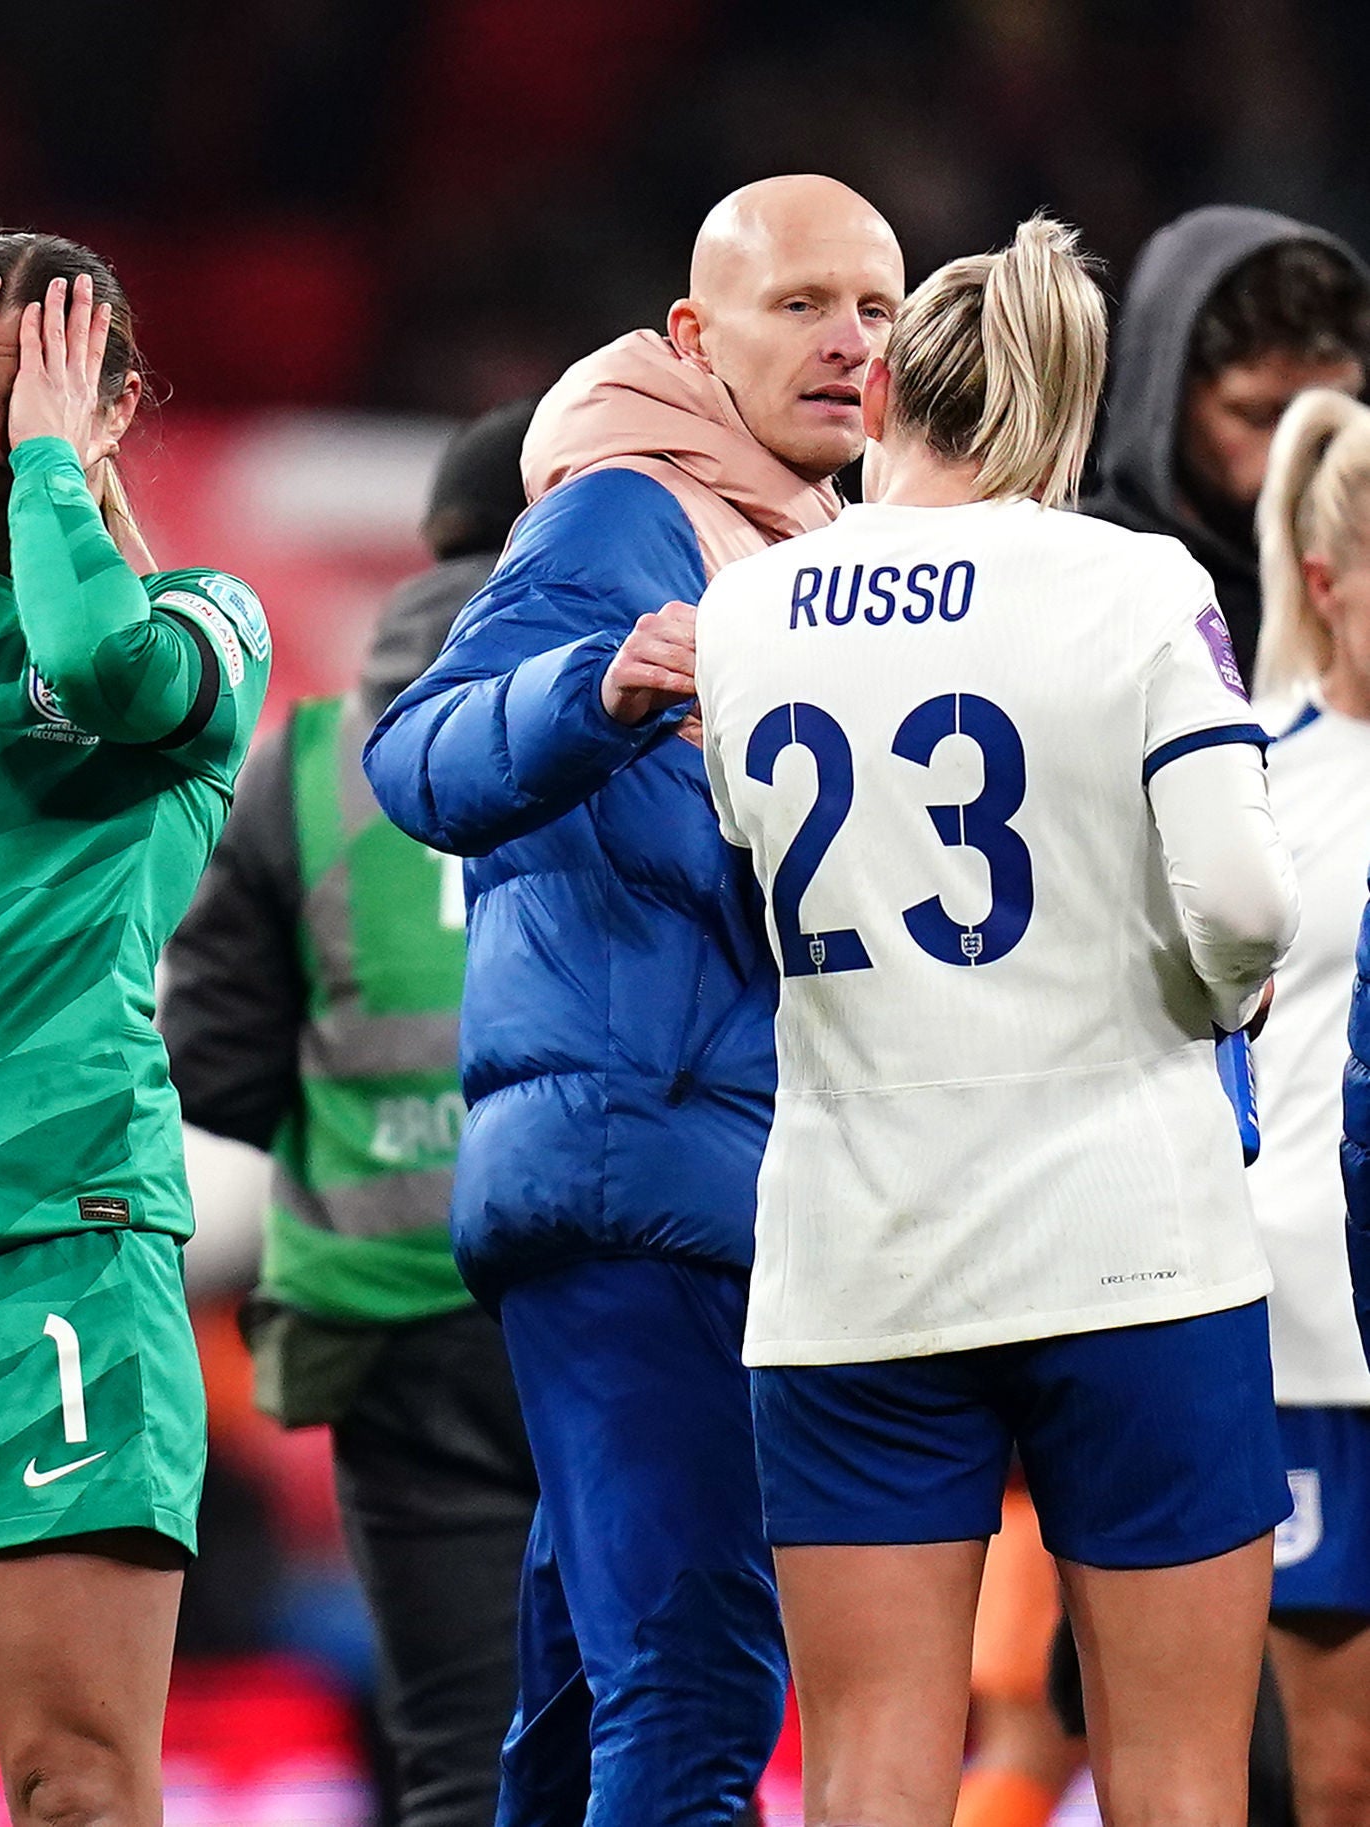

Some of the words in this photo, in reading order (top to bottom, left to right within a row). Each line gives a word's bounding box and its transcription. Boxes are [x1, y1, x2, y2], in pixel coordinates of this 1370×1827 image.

[789, 560, 976, 629] RUSSO
[32, 731, 75, 743] DECEMBER
[745, 693, 1034, 977] 23
[42, 1312, 88, 1443] 1
